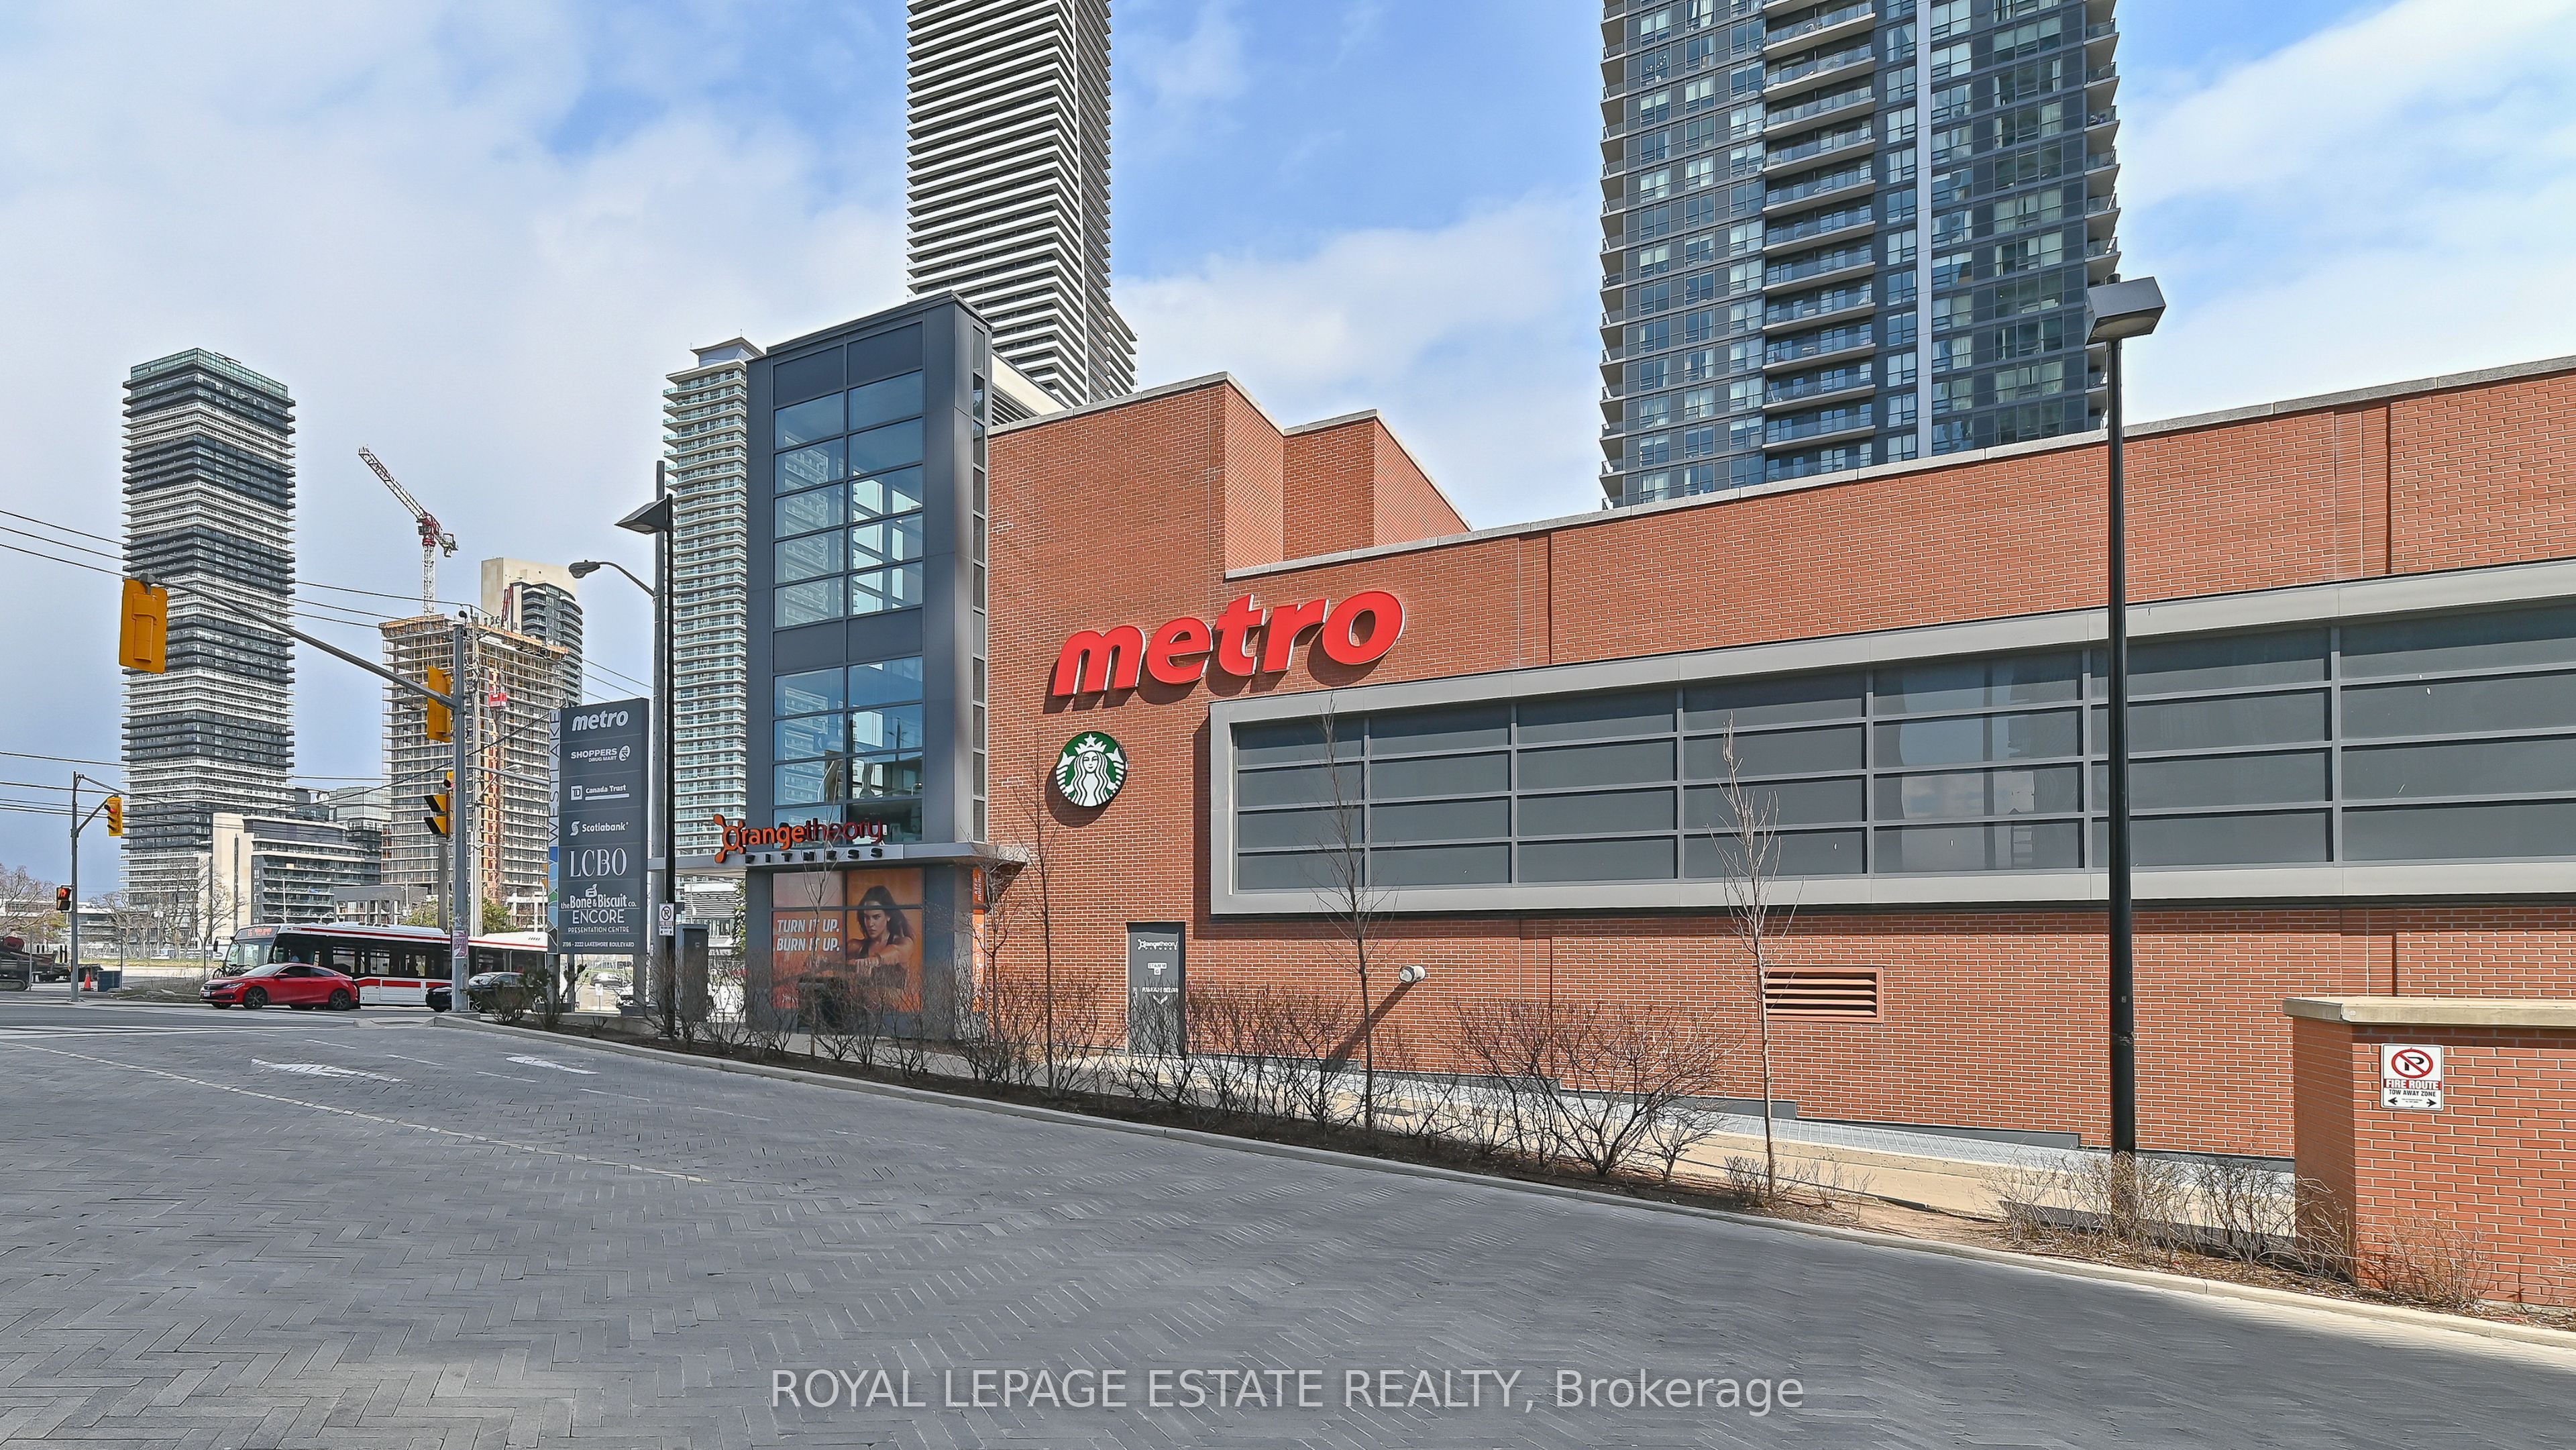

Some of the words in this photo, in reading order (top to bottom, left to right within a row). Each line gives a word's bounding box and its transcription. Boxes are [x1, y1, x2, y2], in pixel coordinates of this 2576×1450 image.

[1052, 590, 1407, 697] metro
[572, 710, 629, 731] metro
[571, 747, 617, 759] SHOPPERS
[549, 711, 559, 843] WESTLAKE
[585, 786, 608, 794] Canada
[609, 784, 627, 792] Trust
[582, 821, 626, 833] Scotiabank
[570, 847, 627, 878] LCBO
[745, 847, 883, 864] FITNESS
[570, 895, 592, 909] Bone
[598, 893, 627, 908] Biscuit
[572, 909, 625, 924] ENCORE
[777, 919, 806, 933] TURN
[808, 919, 820, 933] IT
[822, 919, 840, 933] UP.
[776, 937, 806, 951] BURN
[809, 937, 820, 951] IT
[822, 937, 840, 951] UP.
[2385, 1079, 2407, 1088] FIRE
[2408, 1080, 2439, 1090] ROUTE
